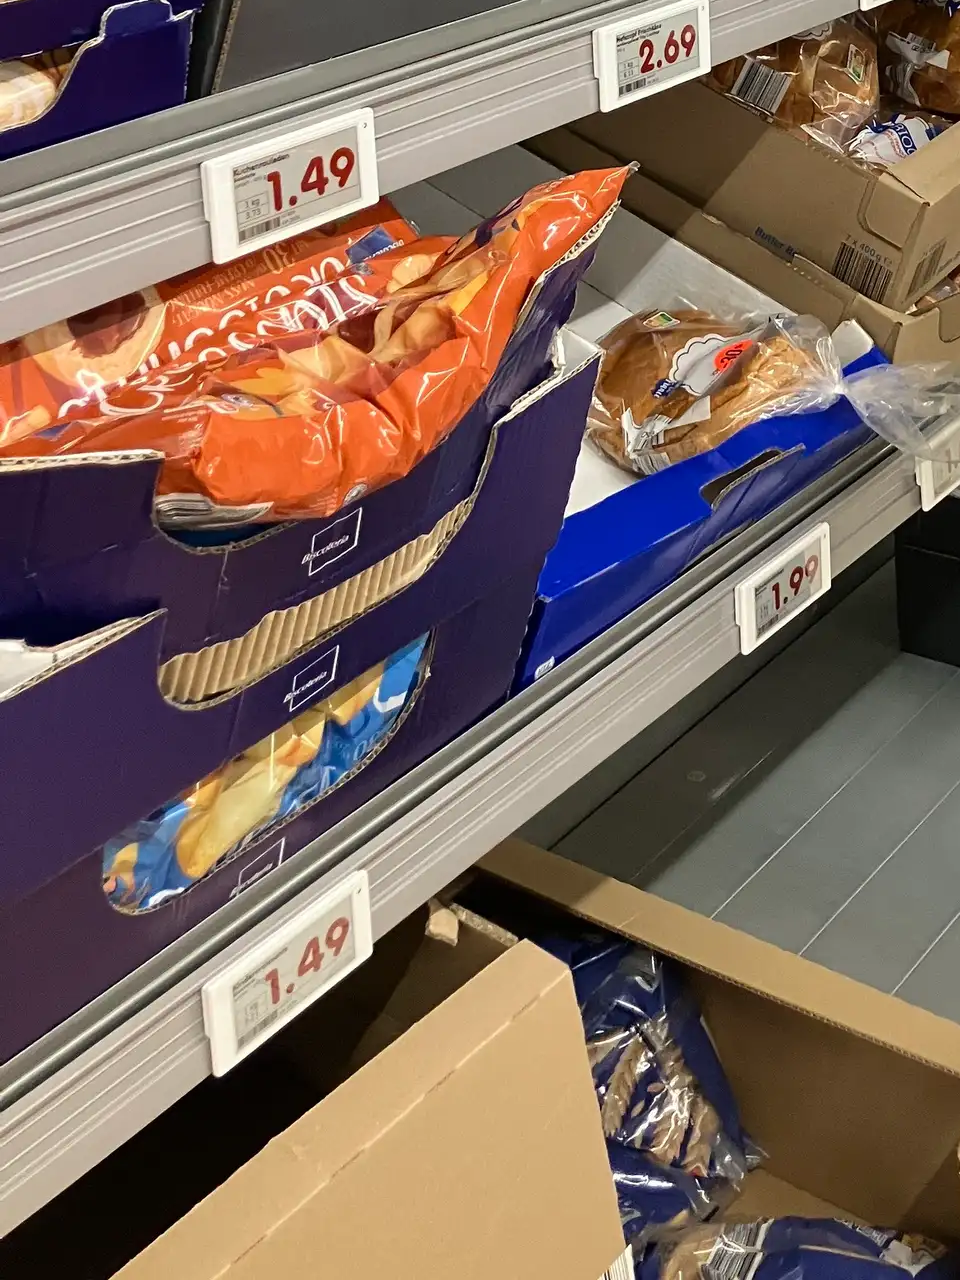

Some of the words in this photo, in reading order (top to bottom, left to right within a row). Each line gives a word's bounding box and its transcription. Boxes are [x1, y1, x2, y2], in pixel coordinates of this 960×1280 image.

[639, 24, 696, 74] 2.69
[267, 147, 355, 212] 1.49
[860, 243, 875, 257] 400
[772, 555, 819, 610] 1.99
[265, 916, 350, 1006] 1.49
